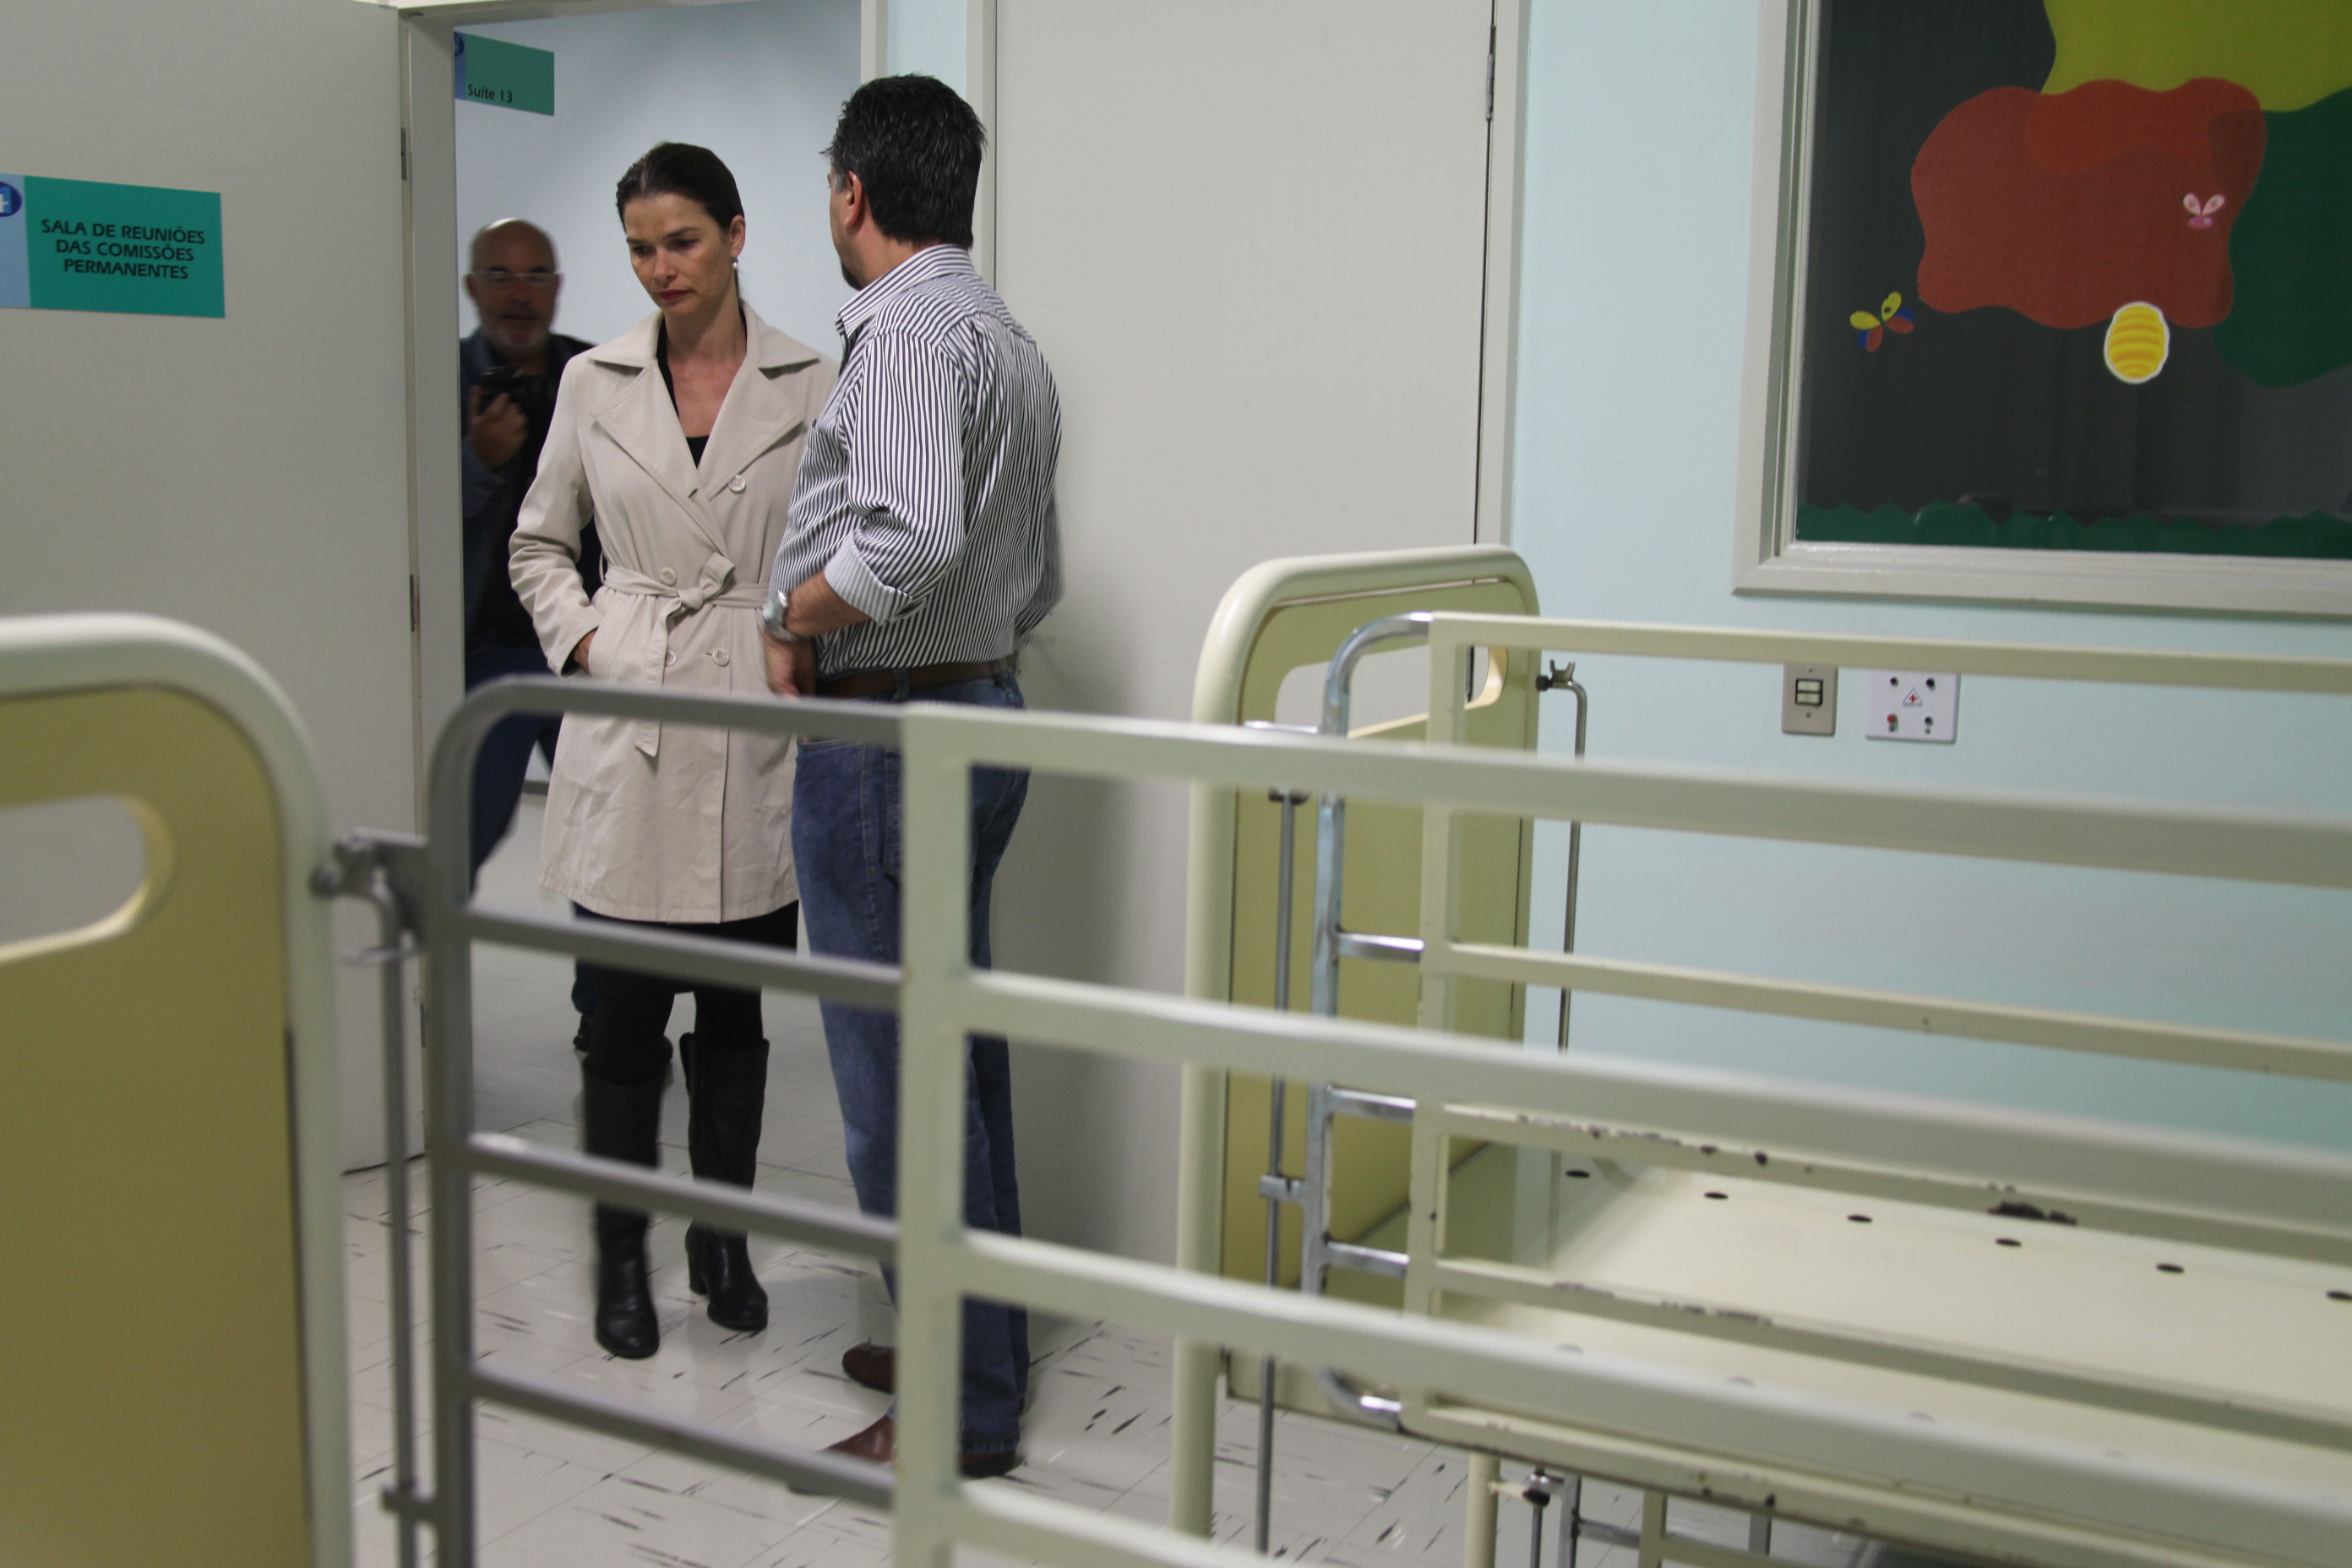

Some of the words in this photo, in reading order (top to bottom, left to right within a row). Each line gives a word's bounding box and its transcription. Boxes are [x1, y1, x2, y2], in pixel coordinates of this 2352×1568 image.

[467, 83, 495, 101] Suite
[500, 90, 513, 104] 13
[41, 219, 88, 236] SALA
[92, 222, 117, 238] DE
[121, 225, 206, 245] REUNIÕES
[56, 239, 92, 255] DAS
[96, 242, 195, 262] COMISSÕES
[63, 259, 189, 280] PERMANENTES
